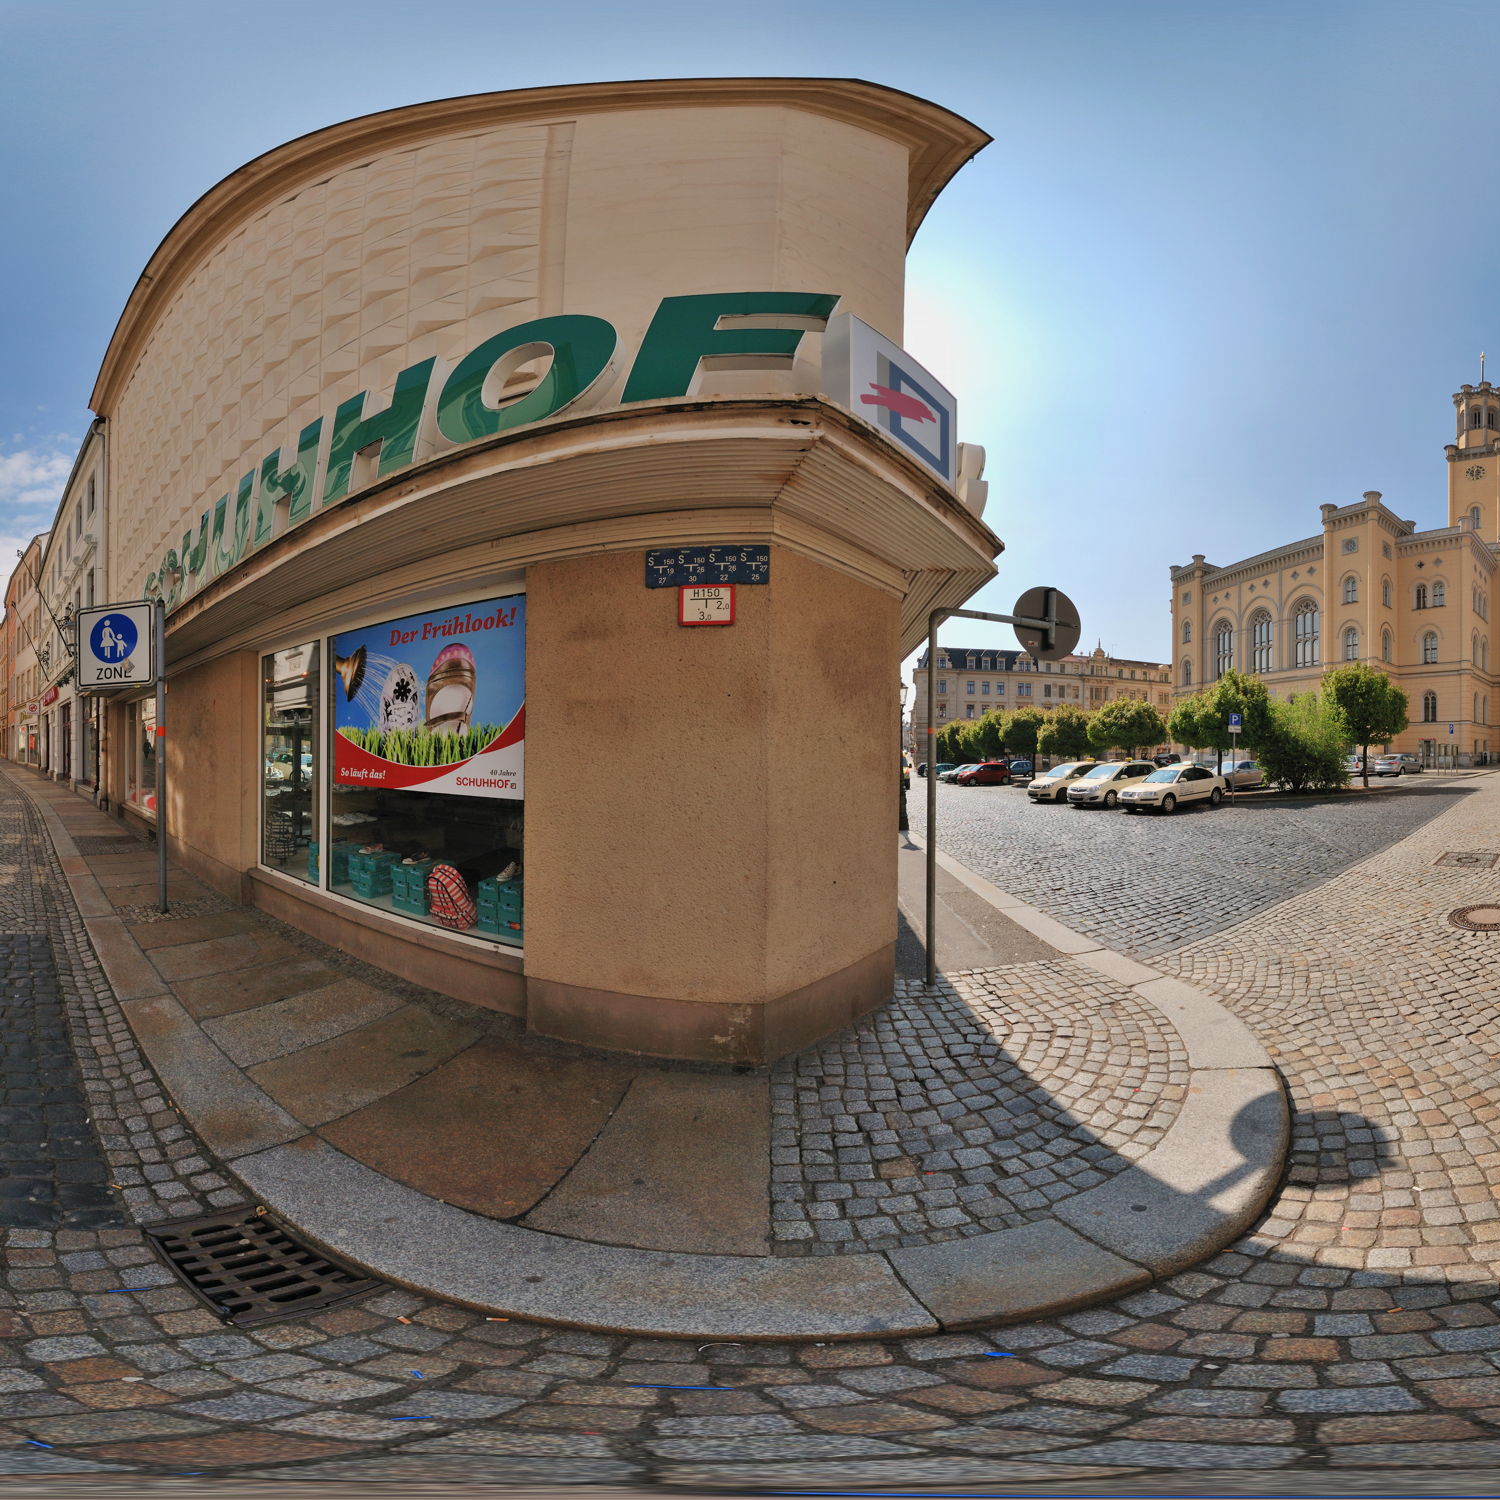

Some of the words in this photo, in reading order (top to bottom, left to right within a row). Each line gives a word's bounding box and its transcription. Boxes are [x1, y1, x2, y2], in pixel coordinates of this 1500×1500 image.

[143, 291, 841, 611] SCHUHHOF
[648, 556, 655, 567] S
[678, 555, 685, 564] S
[709, 553, 716, 563] S
[740, 552, 747, 562] S
[389, 629, 419, 647] Der
[421, 607, 517, 641] Frühlook!
[1231, 714, 1239, 724] P
[340, 767, 350, 777] So
[350, 767, 369, 780] läuft
[368, 769, 386, 780] das!
[498, 769, 517, 777] Jahre
[456, 777, 511, 789] SCHUHHOF
